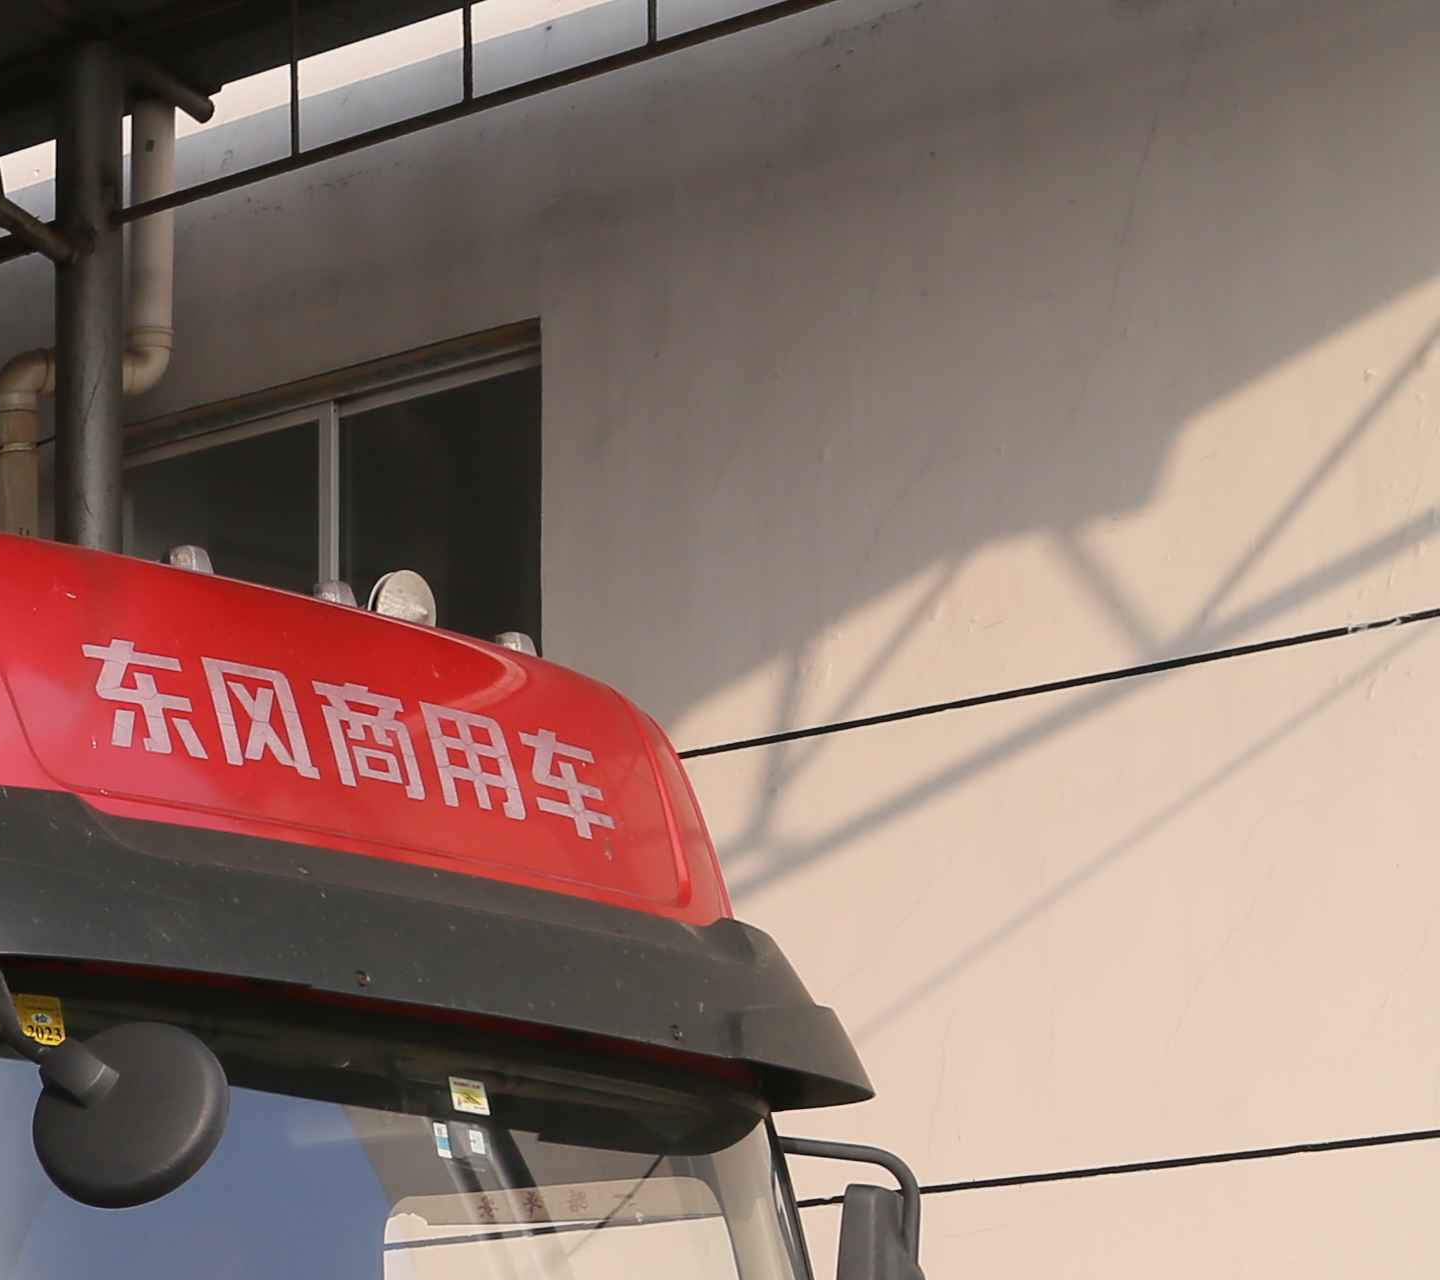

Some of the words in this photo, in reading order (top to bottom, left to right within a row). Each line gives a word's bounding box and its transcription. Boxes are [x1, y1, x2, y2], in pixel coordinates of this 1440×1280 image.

[82, 638, 616, 840] 东风商用车
